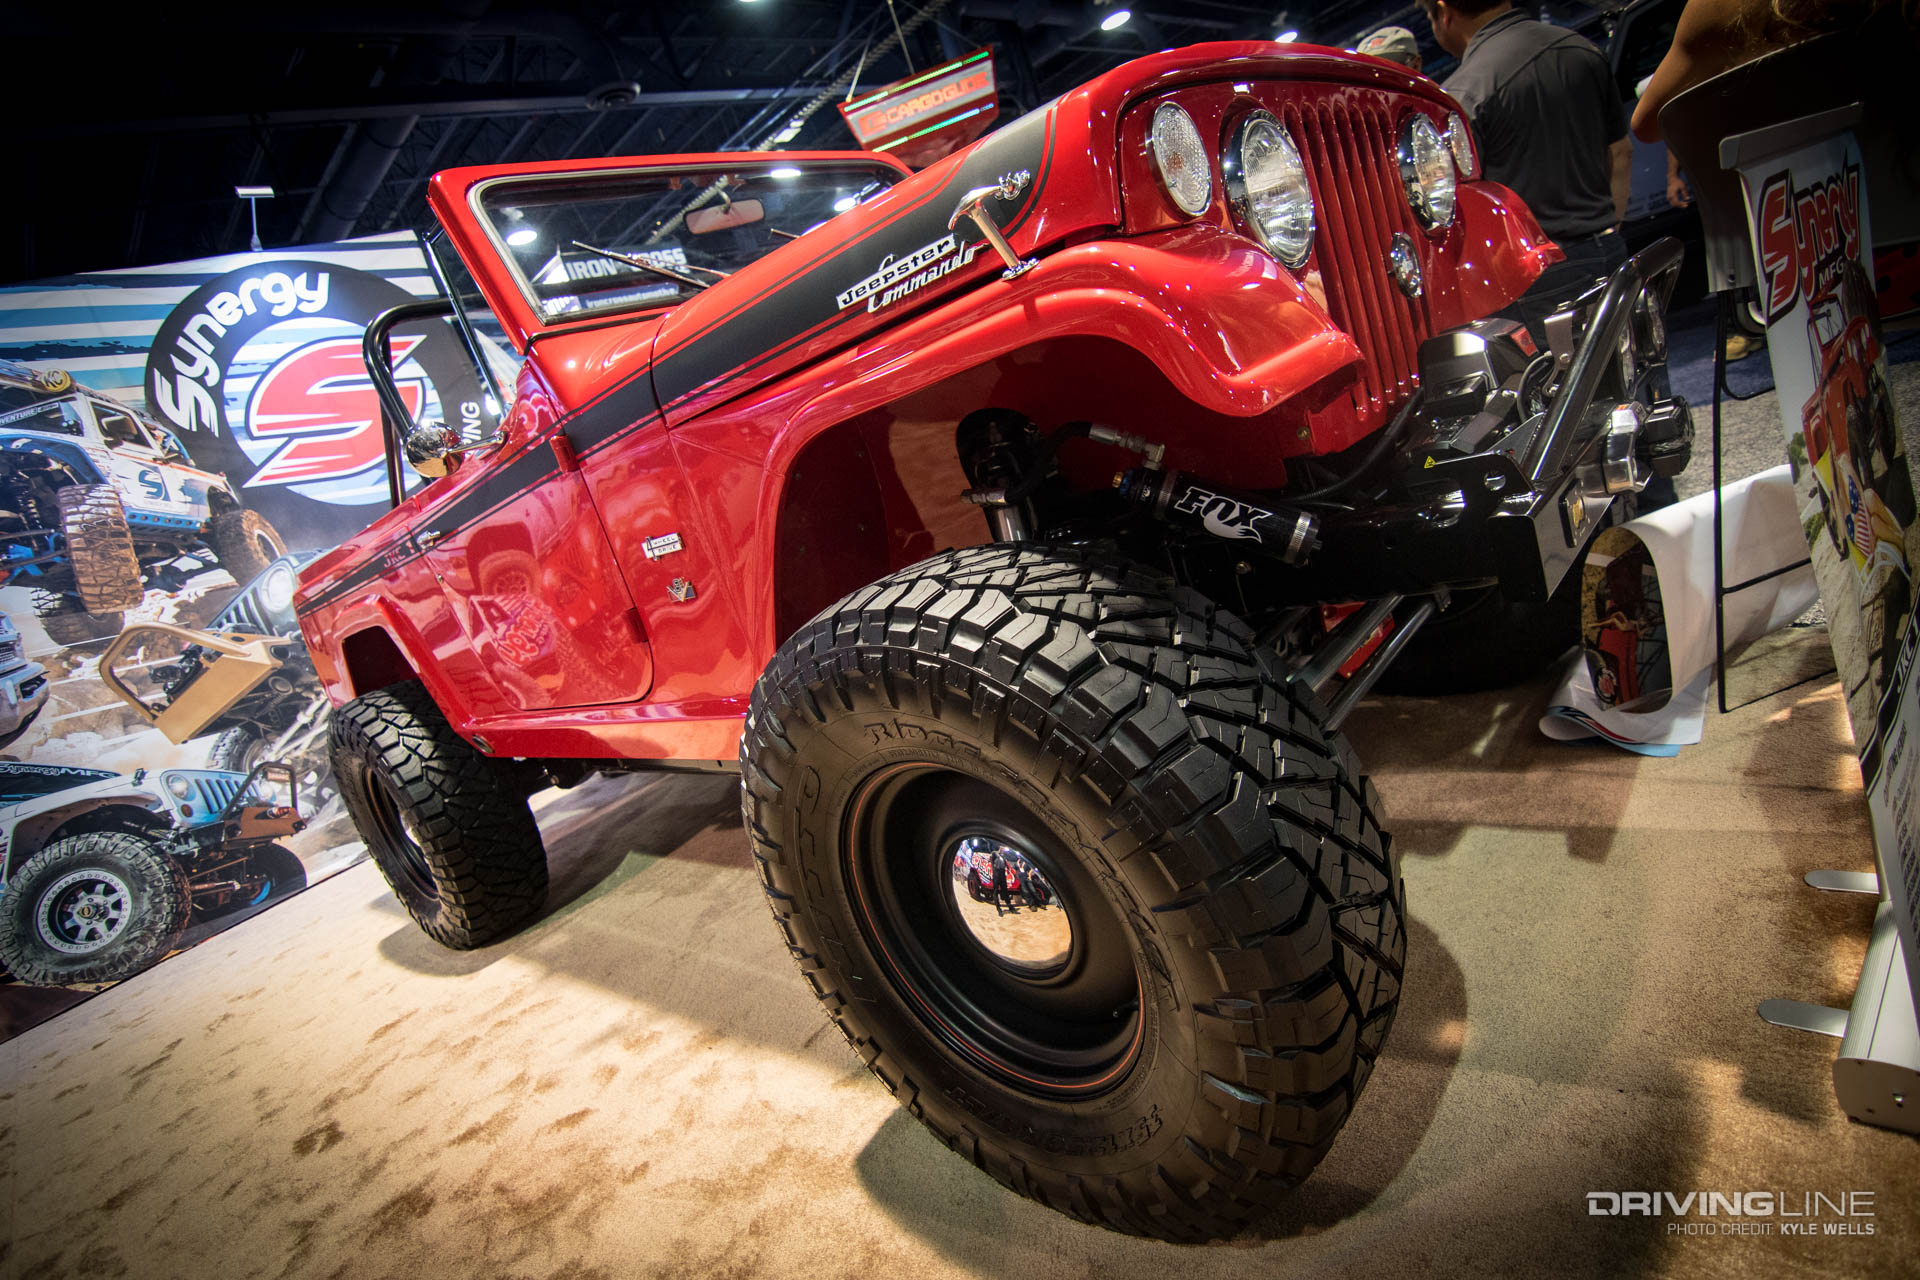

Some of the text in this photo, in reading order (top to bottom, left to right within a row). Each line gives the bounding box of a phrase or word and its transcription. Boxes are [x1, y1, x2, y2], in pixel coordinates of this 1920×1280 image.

[565, 256, 618, 281] IRON
[1757, 147, 1861, 328] Synergy
[841, 239, 951, 306] Jeepster
[866, 239, 990, 313] Commando
[1820, 257, 1844, 286] MFG
[154, 271, 330, 438] Synergy
[1173, 485, 1275, 544] FOX
